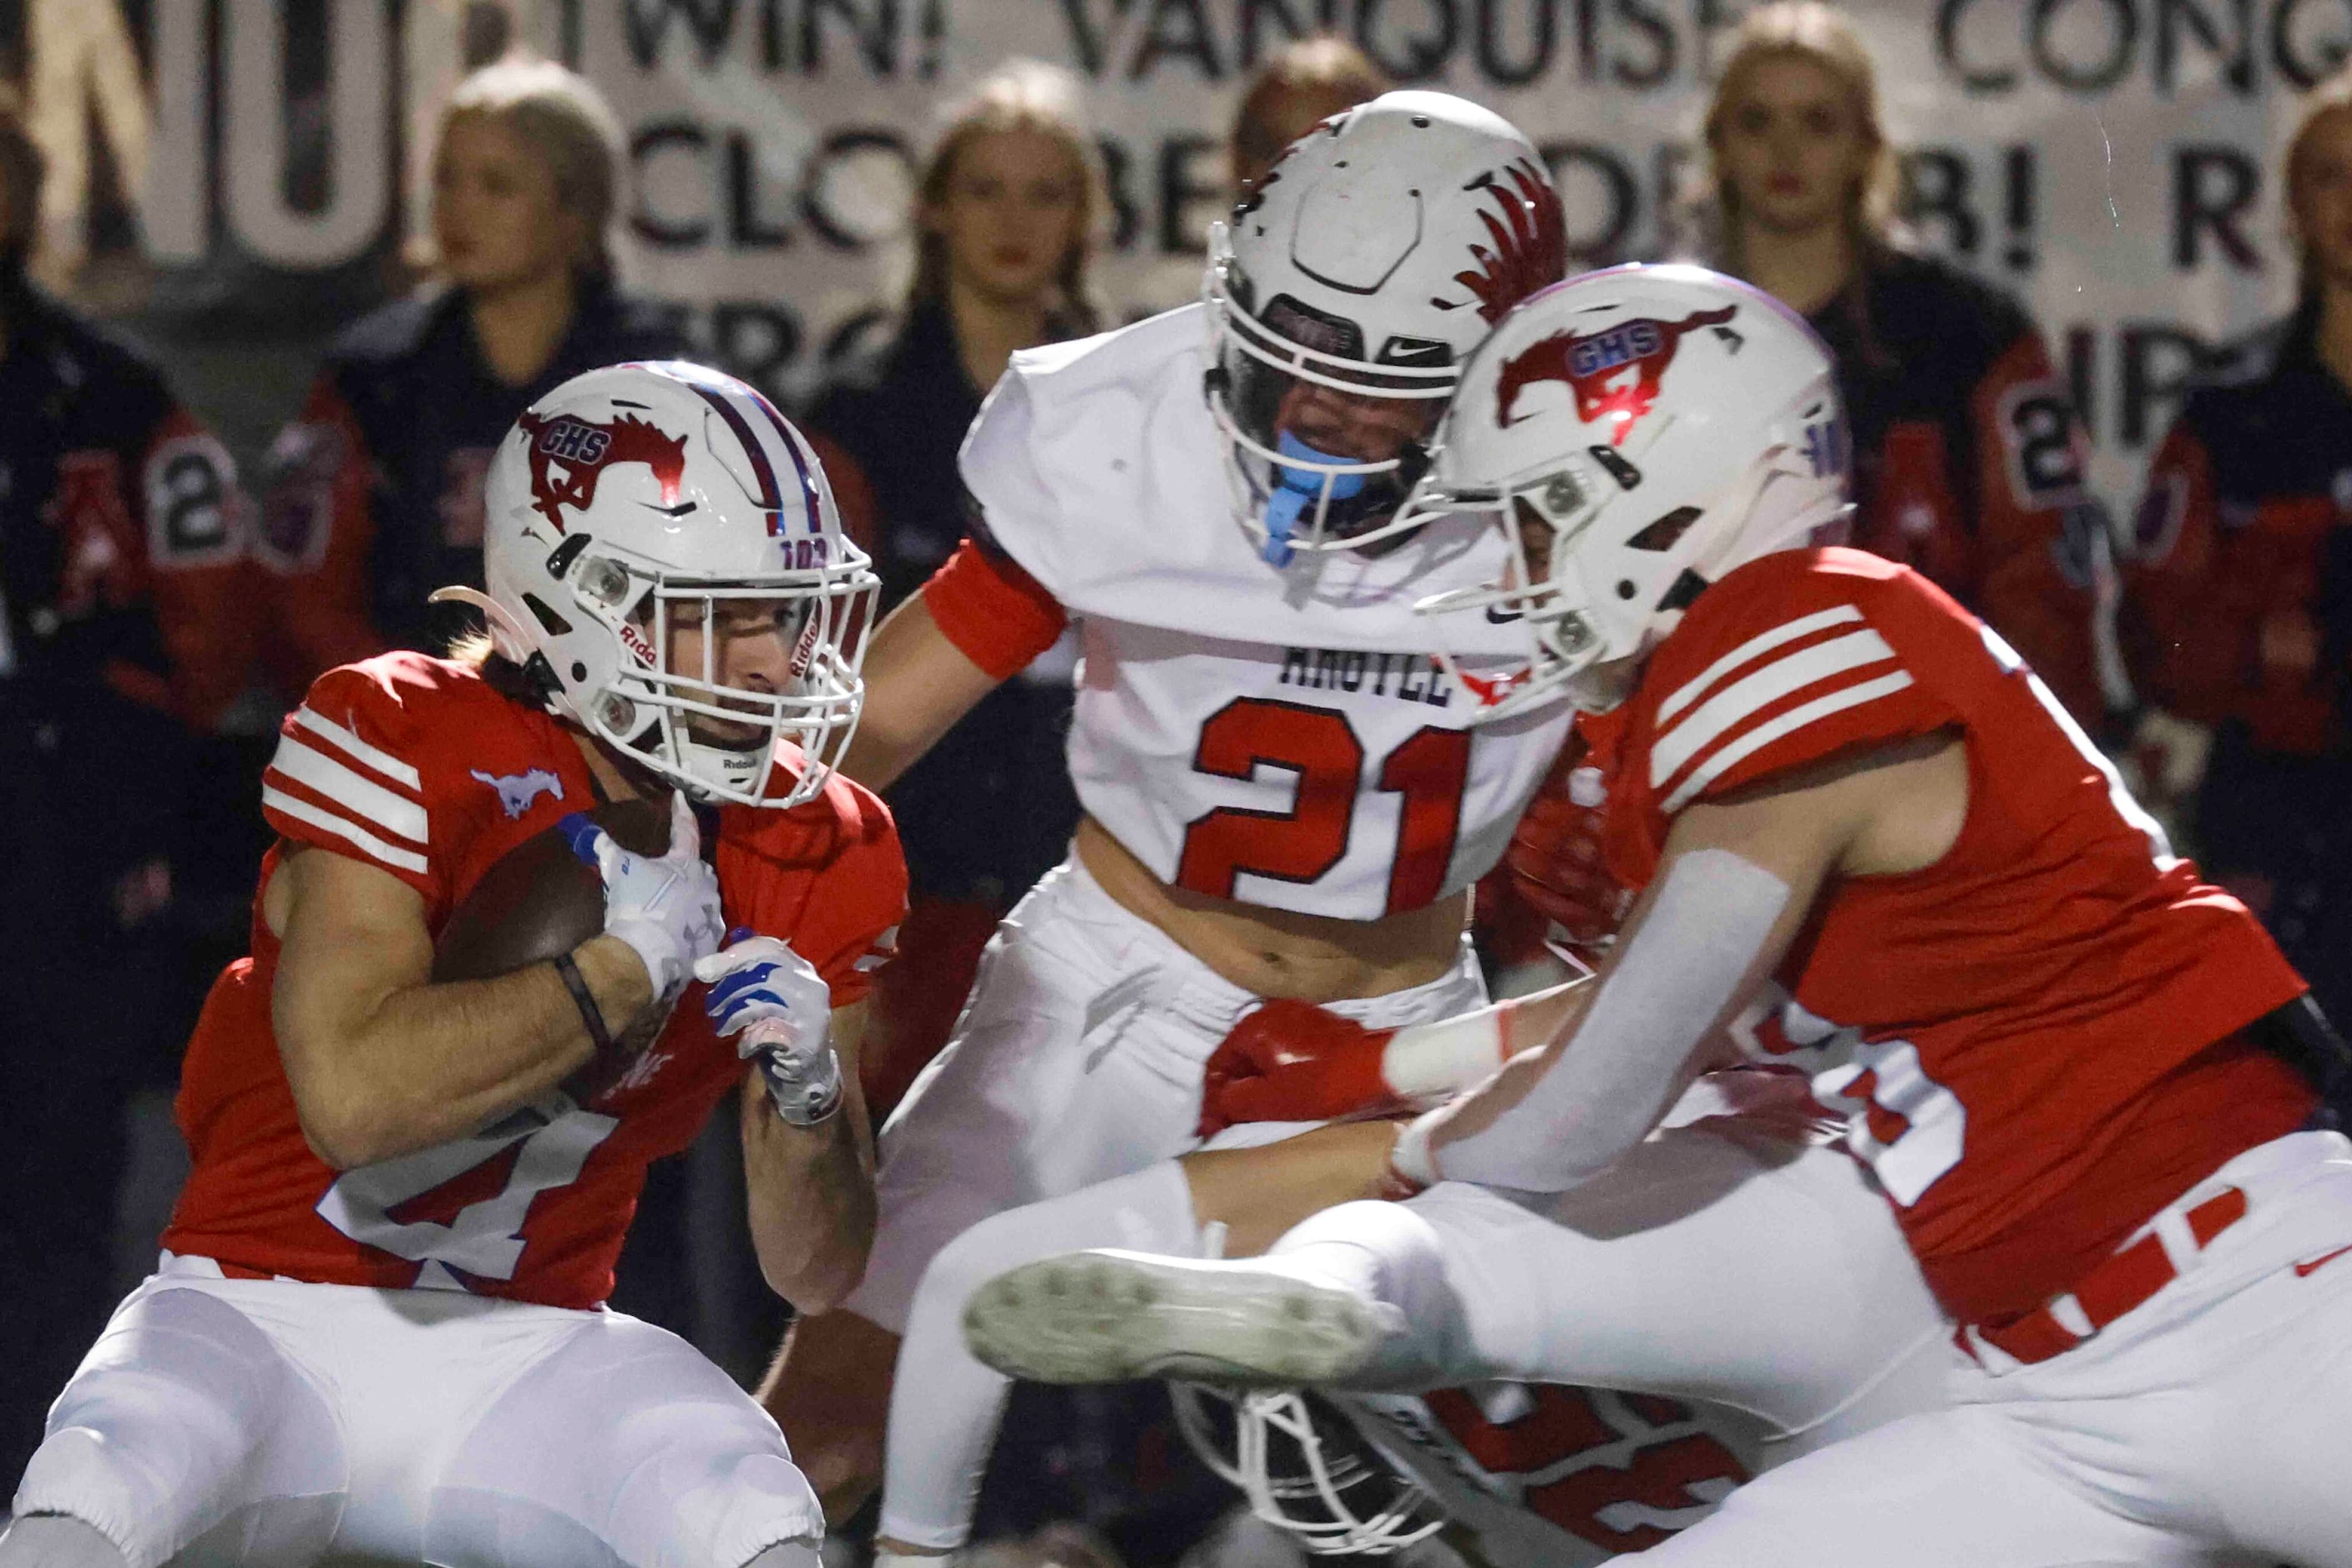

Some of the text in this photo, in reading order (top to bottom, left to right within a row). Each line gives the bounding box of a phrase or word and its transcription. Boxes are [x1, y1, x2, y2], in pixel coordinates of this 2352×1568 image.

[1566, 322, 1663, 378] GHS
[539, 421, 611, 465] GHS
[1176, 695, 1472, 918] 21
